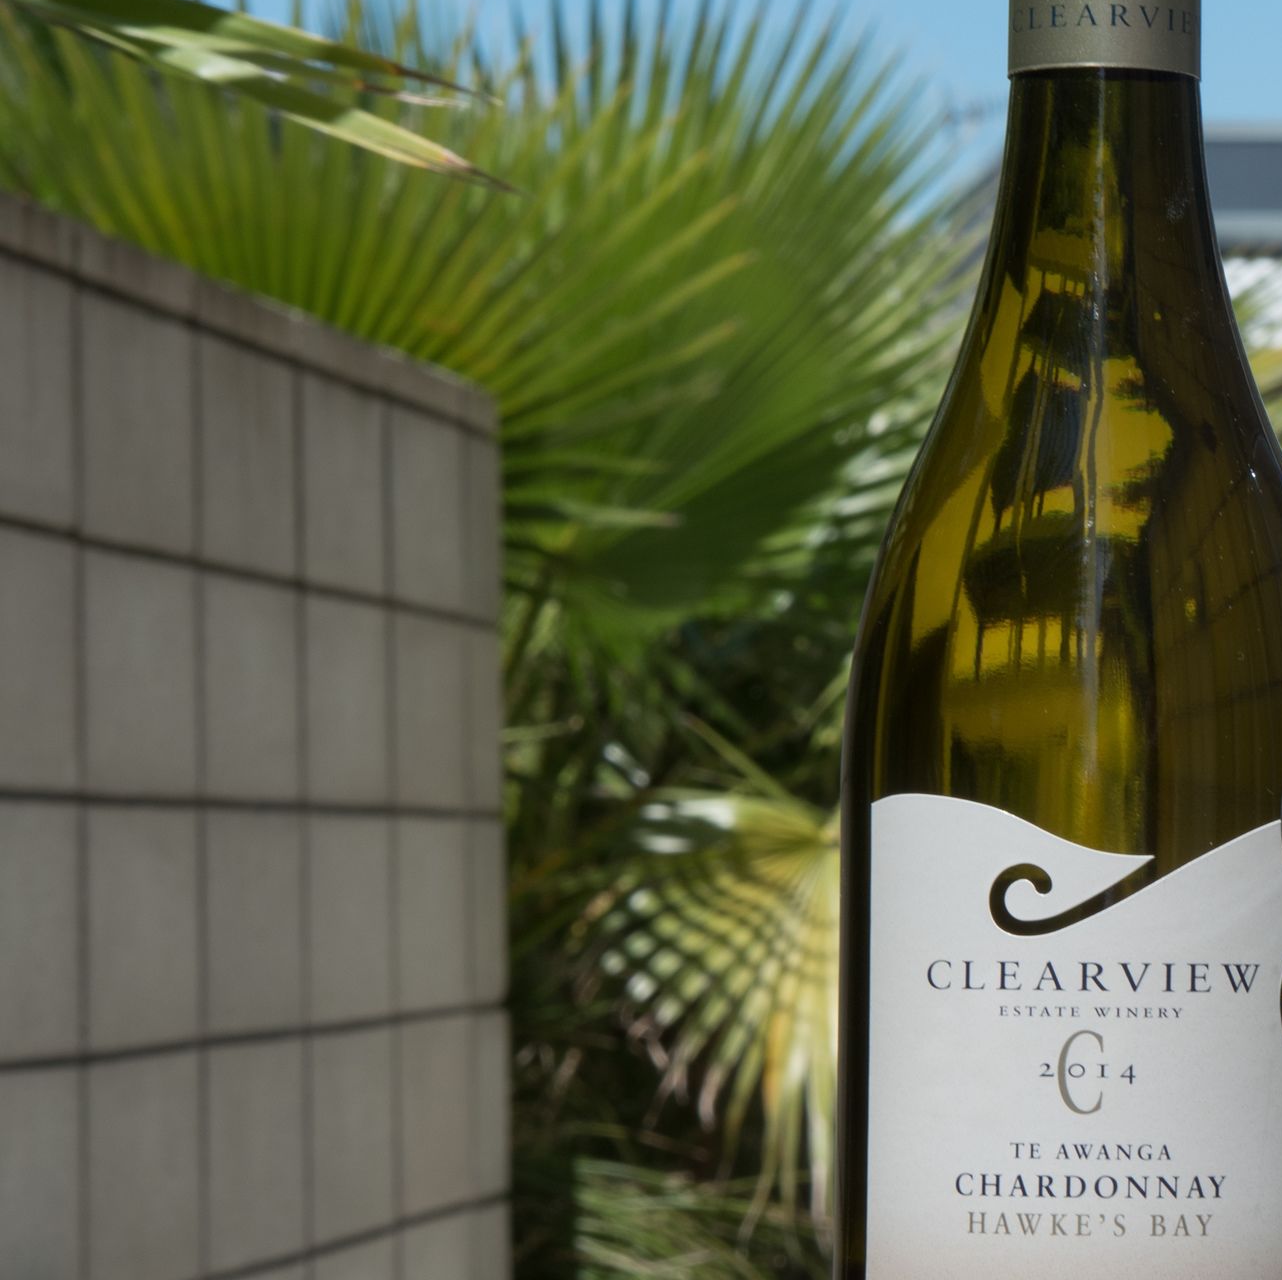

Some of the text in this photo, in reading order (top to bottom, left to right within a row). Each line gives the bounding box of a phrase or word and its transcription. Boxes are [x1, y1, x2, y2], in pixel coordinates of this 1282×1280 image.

[1012, 3, 1197, 34] CLEARVIE
[926, 959, 1261, 994] CLEARVIEW
[999, 1005, 1183, 1019] ESTATE WINERY
[1039, 1062, 1137, 1085] 2014
[1009, 1142, 1172, 1161] TE AWANGA
[955, 1172, 1227, 1199] CHARDONNAY
[967, 1211, 1213, 1238] HAWKE'S BAY
